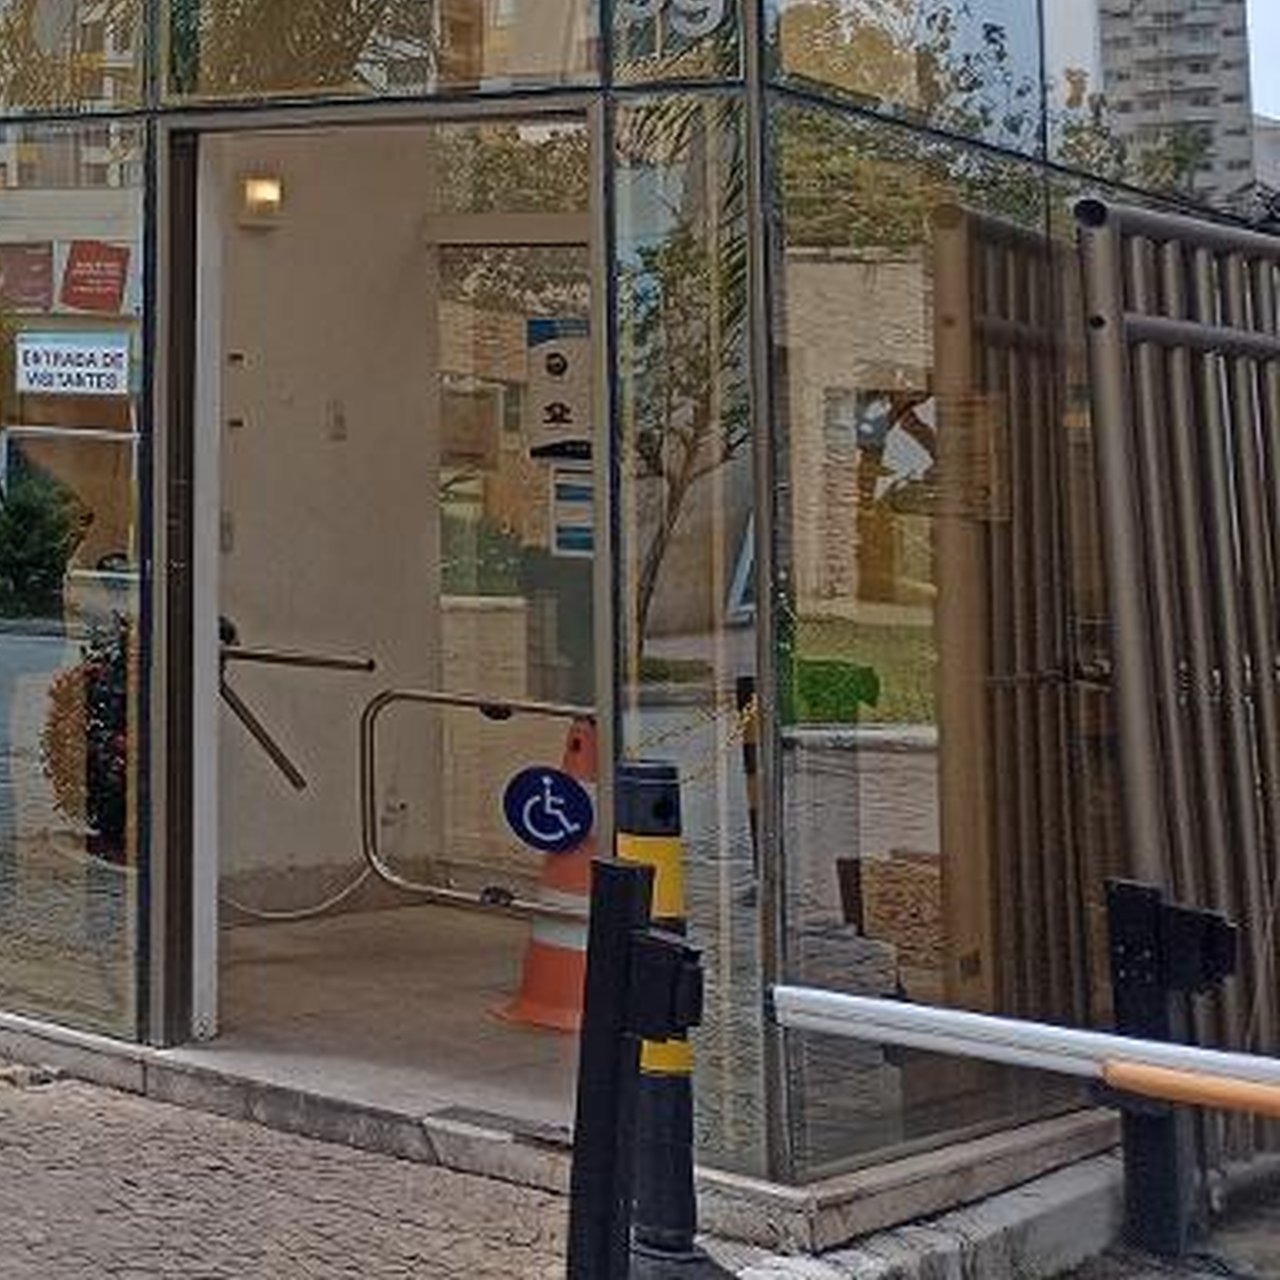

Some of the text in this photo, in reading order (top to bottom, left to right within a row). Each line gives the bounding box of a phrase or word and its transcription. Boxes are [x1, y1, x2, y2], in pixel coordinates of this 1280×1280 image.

[23, 349, 124, 369] ENTRADA DE
[26, 371, 118, 389] VISITANTES
